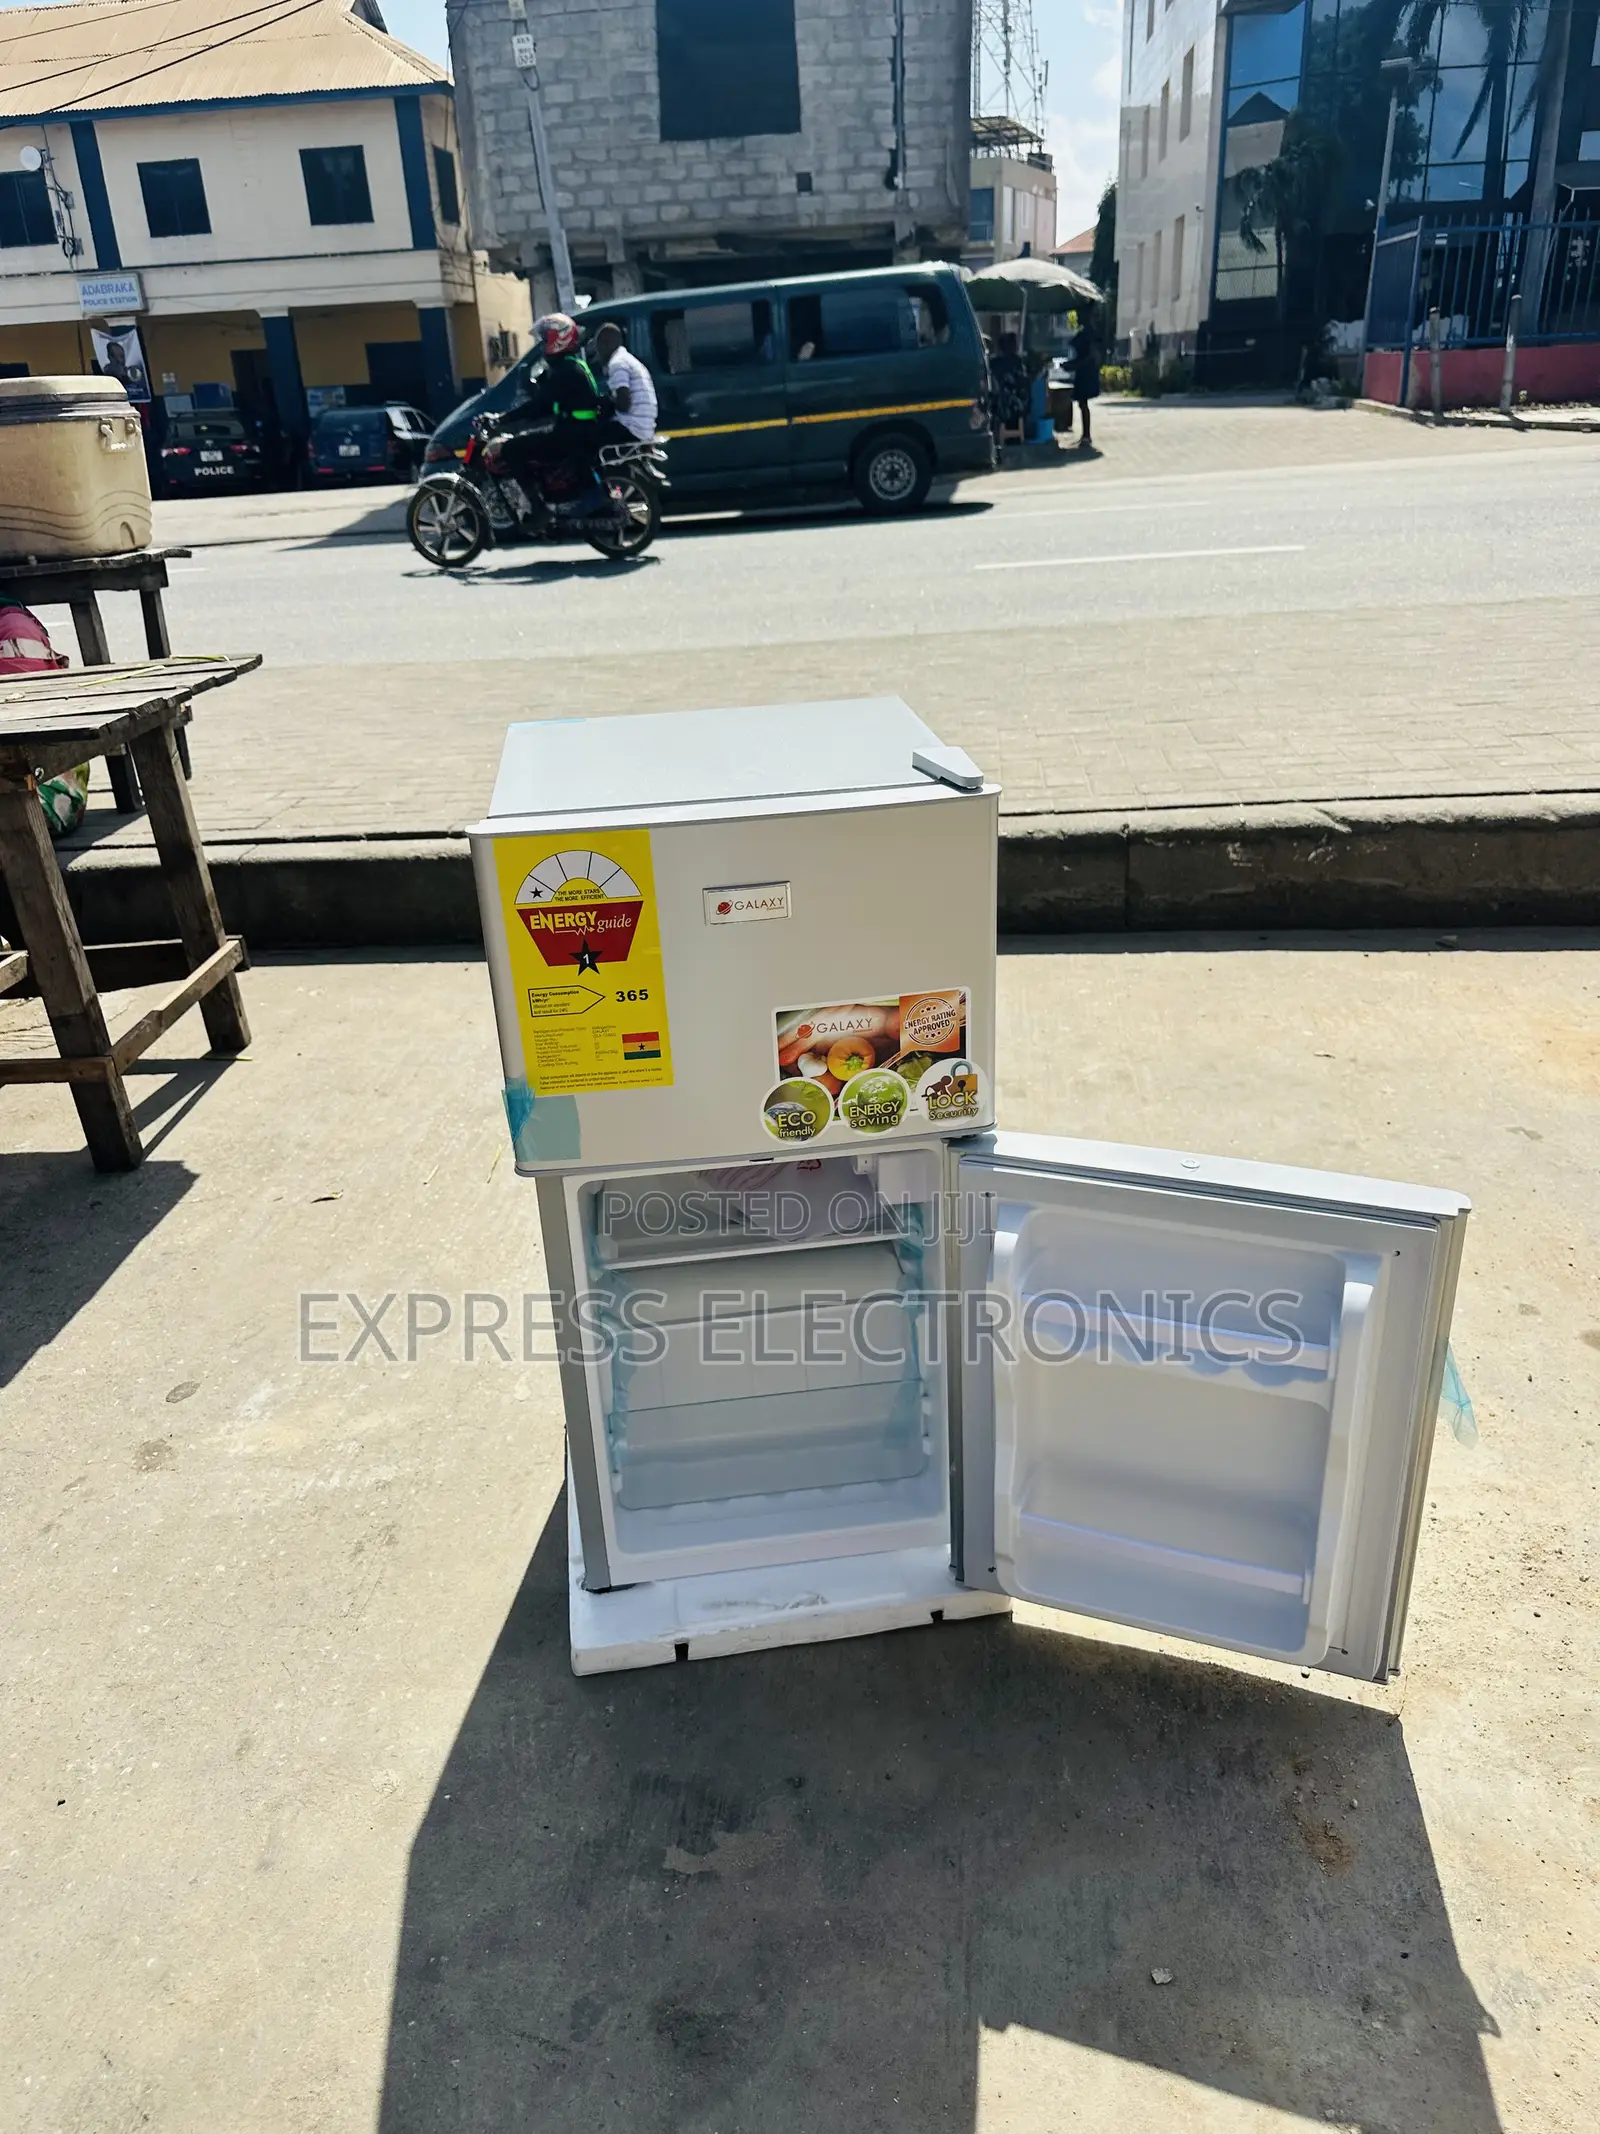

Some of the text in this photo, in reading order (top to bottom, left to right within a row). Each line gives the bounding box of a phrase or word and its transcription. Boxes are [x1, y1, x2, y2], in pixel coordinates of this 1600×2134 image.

[82, 282, 136, 296] ADABRAKA
[83, 296, 138, 306] POLICE STATION
[194, 466, 234, 476] POLICE
[734, 897, 784, 911] GALAXY
[529, 909, 632, 934] ENERGY guide
[583, 953, 590, 965] 1
[549, 989, 580, 997] Consumption
[615, 988, 649, 1003] 365
[816, 1018, 873, 1034] GALAXY
[904, 1008, 956, 1030] ENERGY RATING
[913, 1019, 951, 1036] APPROVED
[928, 1091, 977, 1110] LOCK
[850, 1101, 900, 1119] ENERGY
[928, 1106, 979, 1121] Security
[778, 1111, 816, 1128] ECO
[851, 1113, 900, 1128] saving
[778, 1125, 816, 1138] friendly
